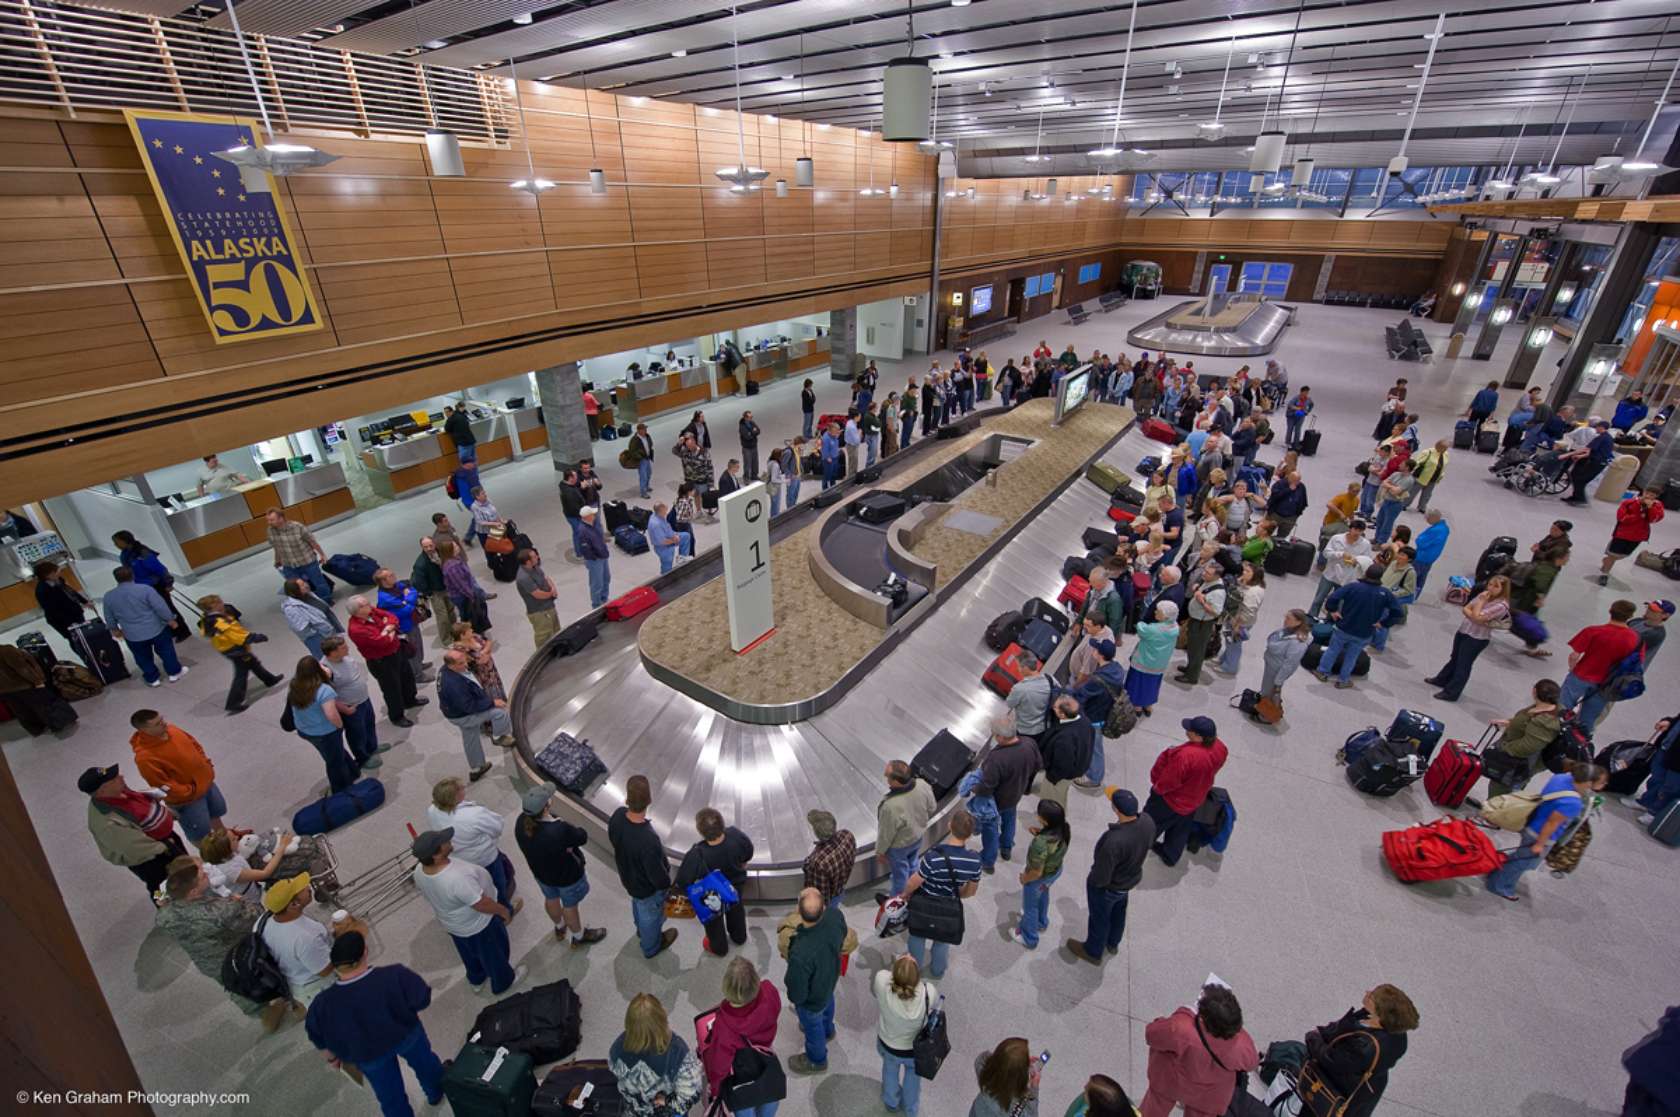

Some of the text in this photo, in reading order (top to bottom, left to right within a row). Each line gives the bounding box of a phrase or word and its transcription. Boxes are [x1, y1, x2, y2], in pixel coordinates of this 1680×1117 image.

[177, 211, 274, 220] CELEBRATING
[181, 219, 276, 229] STATEHOOD
[191, 237, 288, 261] ALASKA
[206, 260, 306, 331] 50
[749, 540, 765, 572] 1
